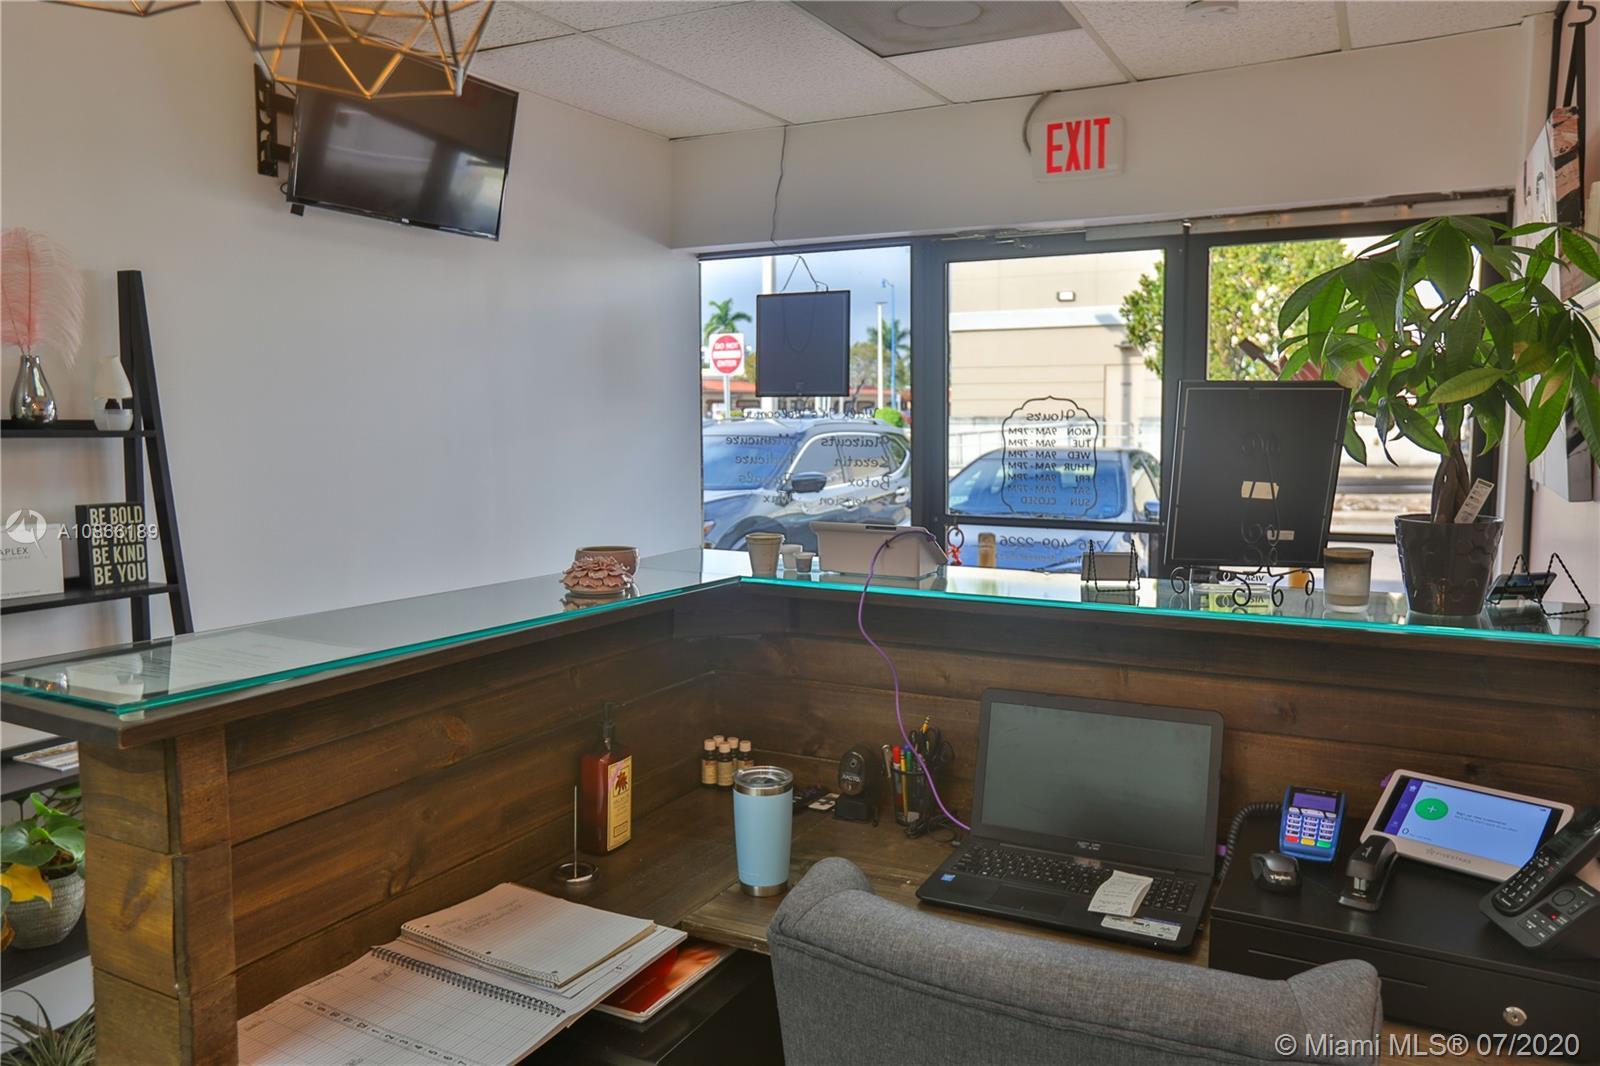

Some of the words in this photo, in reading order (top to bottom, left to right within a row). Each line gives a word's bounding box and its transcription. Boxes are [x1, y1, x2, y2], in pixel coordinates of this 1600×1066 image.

[1046, 117, 1111, 174] EXIT
[714, 341, 725, 350] DO
[726, 341, 739, 350] NOT
[715, 359, 737, 367] ENTER
[89, 507, 107, 526] BE
[110, 505, 143, 525] BOLD
[92, 547, 111, 566] BE
[113, 544, 146, 564] KIND
[94, 566, 114, 586] BE
[117, 563, 147, 582] YOU
